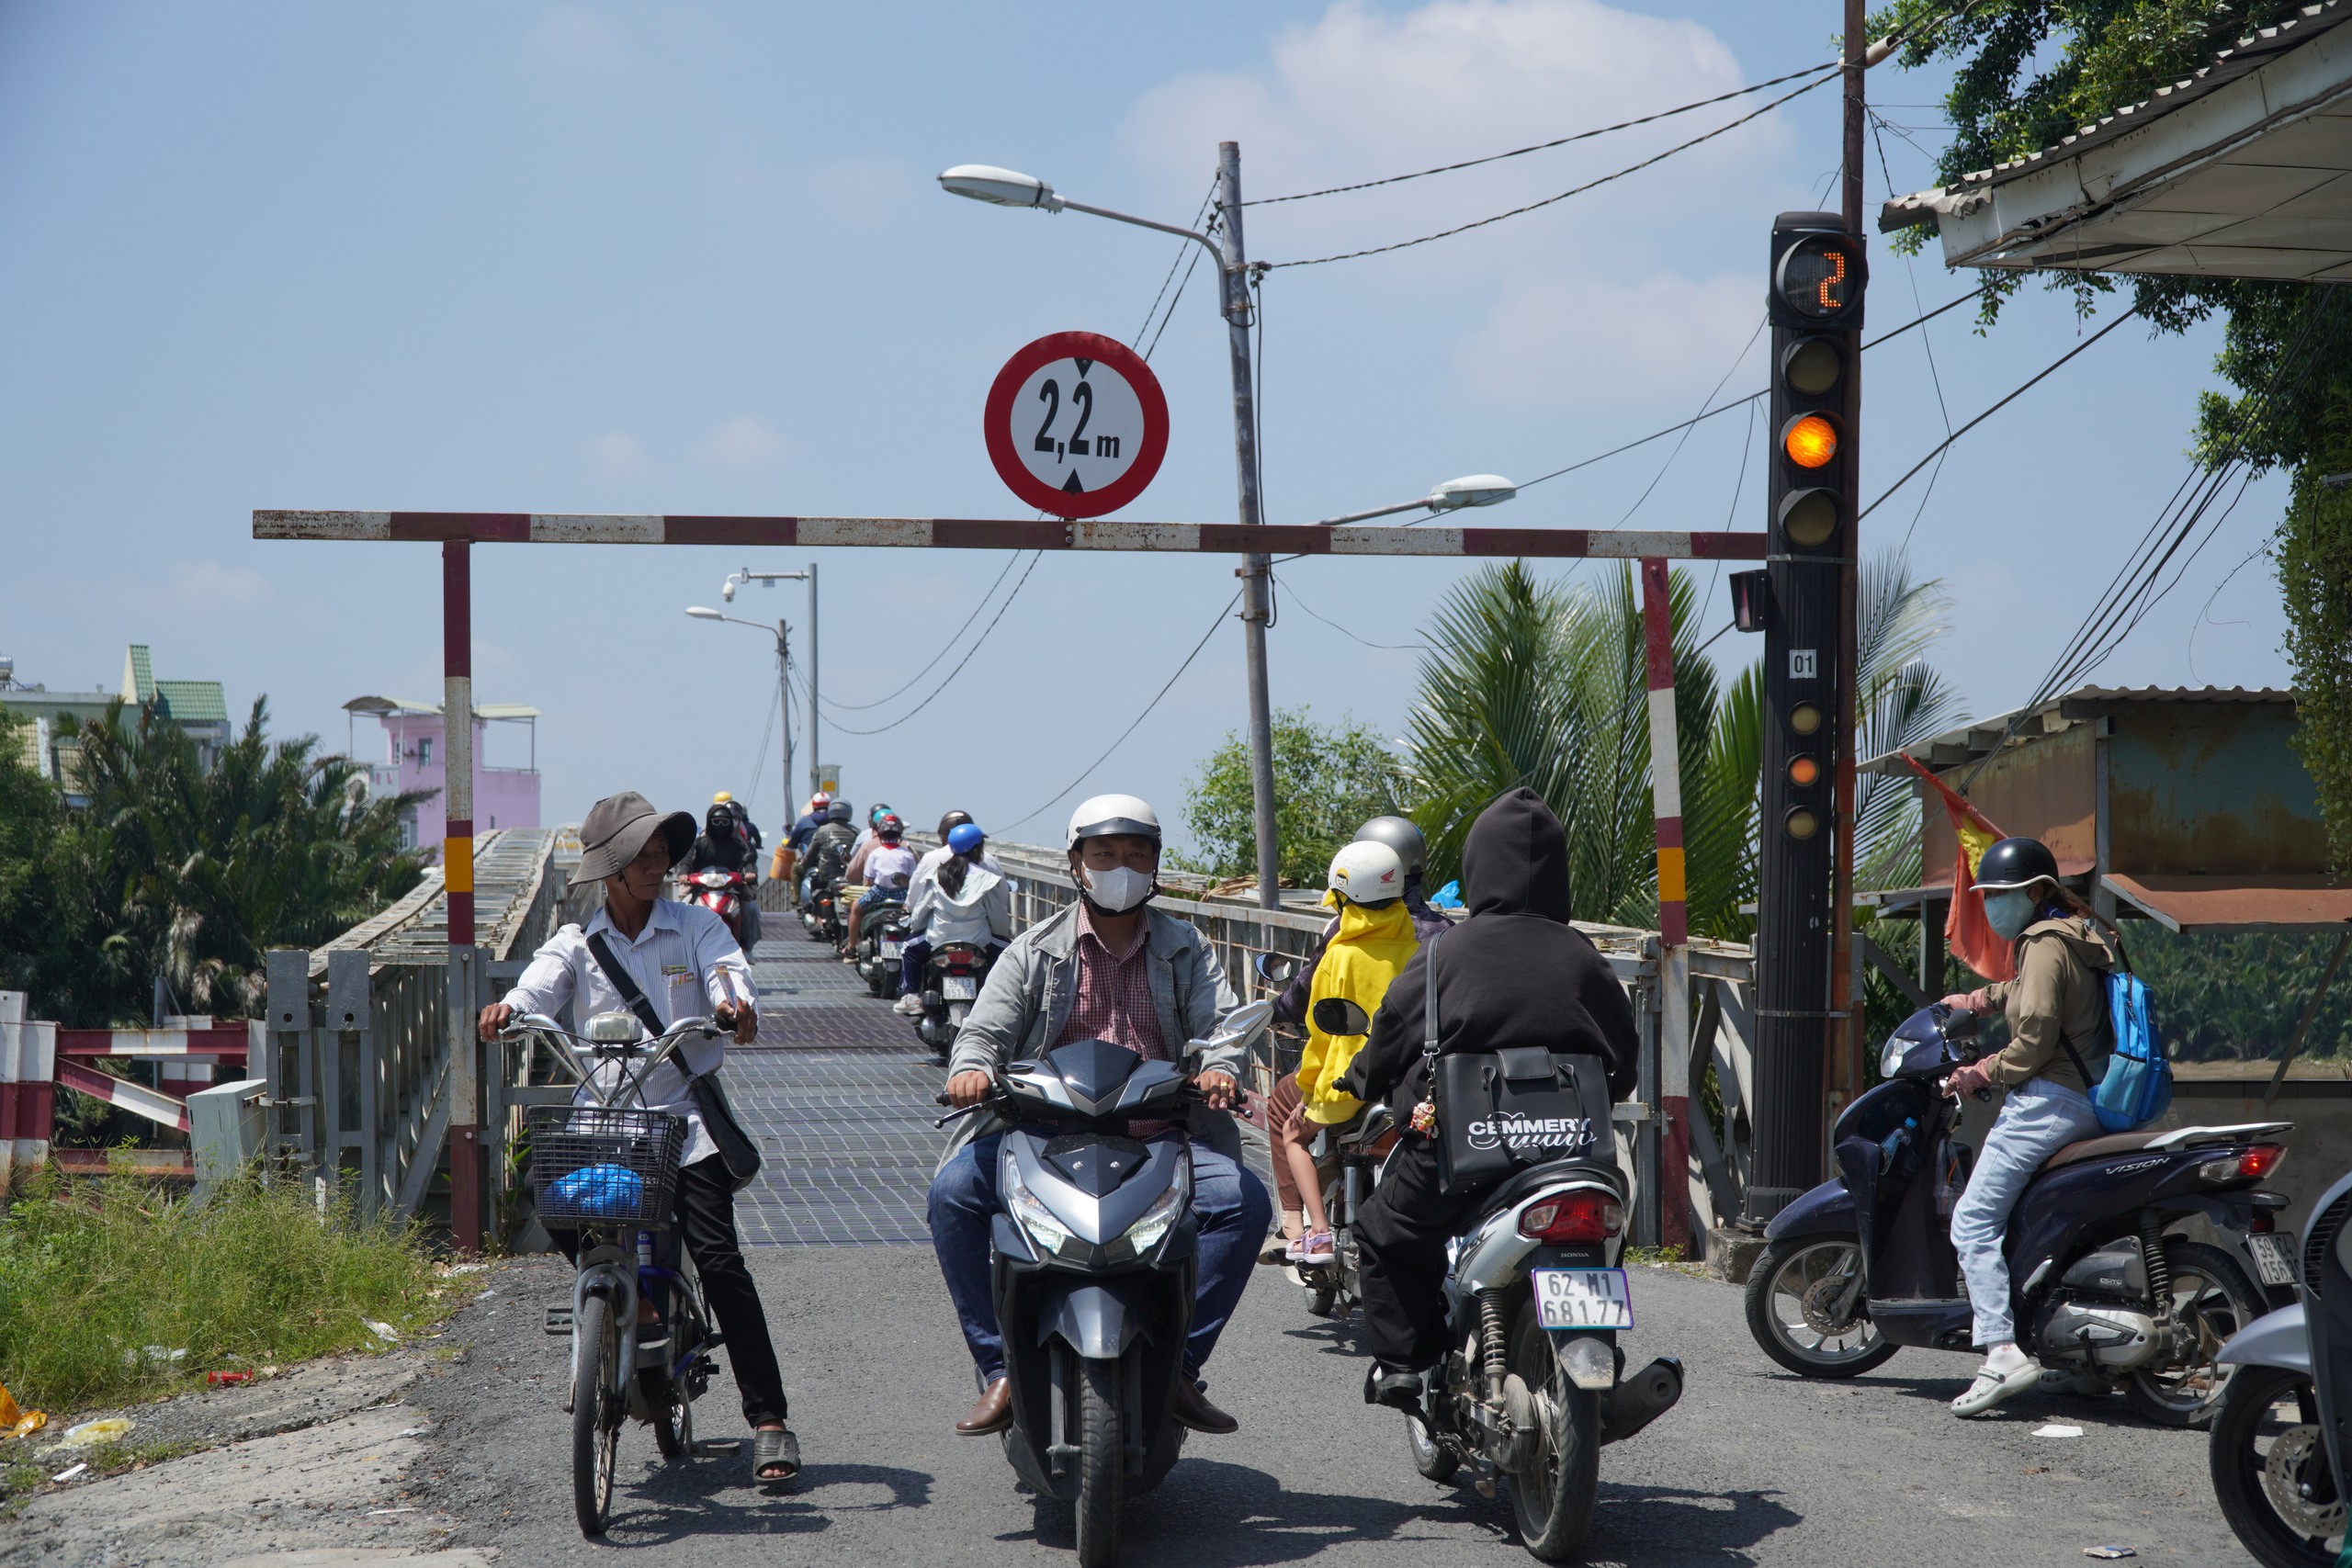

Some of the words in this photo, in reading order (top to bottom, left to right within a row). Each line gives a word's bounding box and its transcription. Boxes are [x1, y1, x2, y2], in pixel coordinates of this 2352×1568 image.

[1819, 252, 1845, 308] 2
[1793, 655, 1813, 673] 01
[1468, 1118, 1591, 1136] CEMMERY
[2106, 1156, 2171, 1175] VISION
[1544, 1300, 1624, 1325] 681.77
